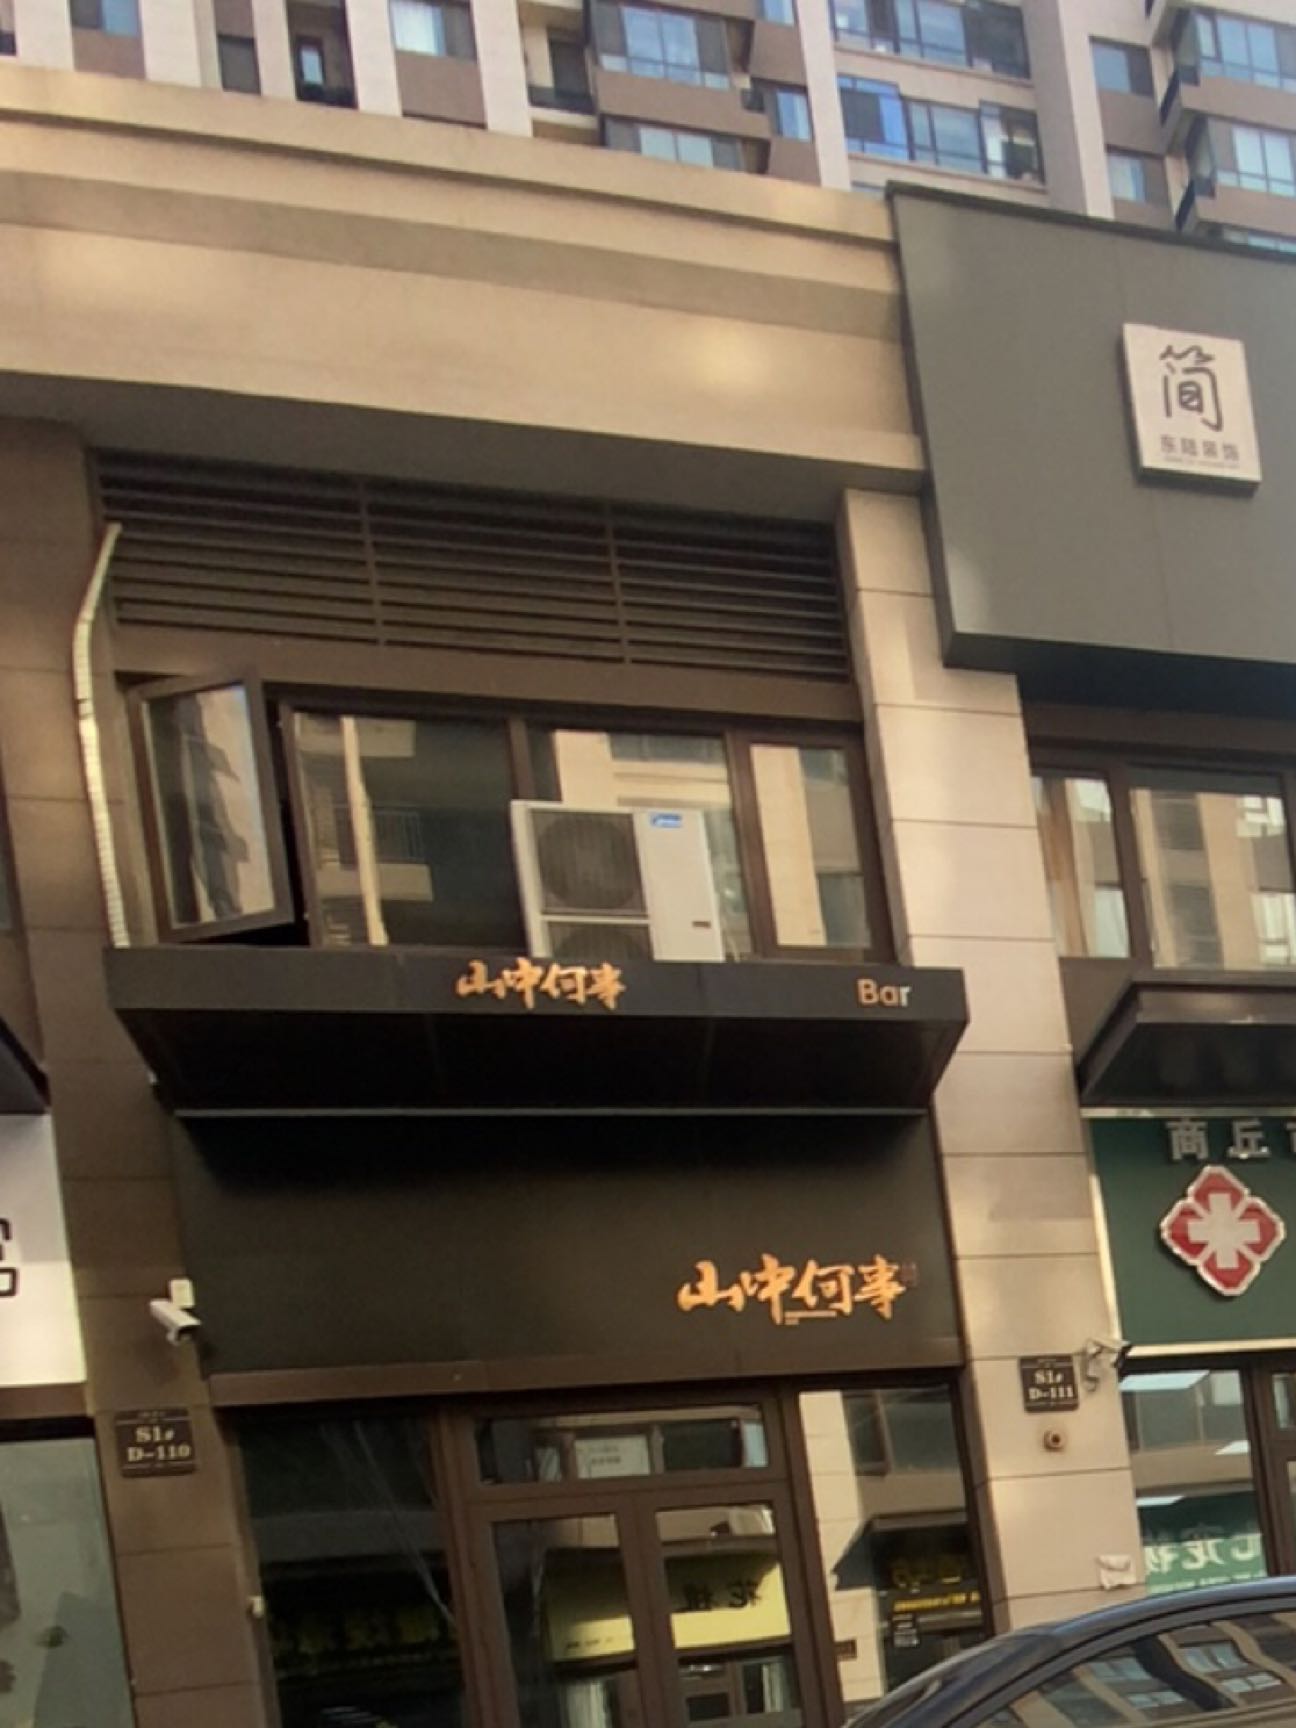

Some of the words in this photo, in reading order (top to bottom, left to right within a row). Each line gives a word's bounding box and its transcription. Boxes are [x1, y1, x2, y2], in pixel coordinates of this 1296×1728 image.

[1159, 344, 1223, 432] 简
[455, 957, 625, 1010] 山中何事
[857, 978, 911, 1008] Bar
[677, 1253, 906, 1325] 山中何事
[127, 1444, 191, 1462] D-110
